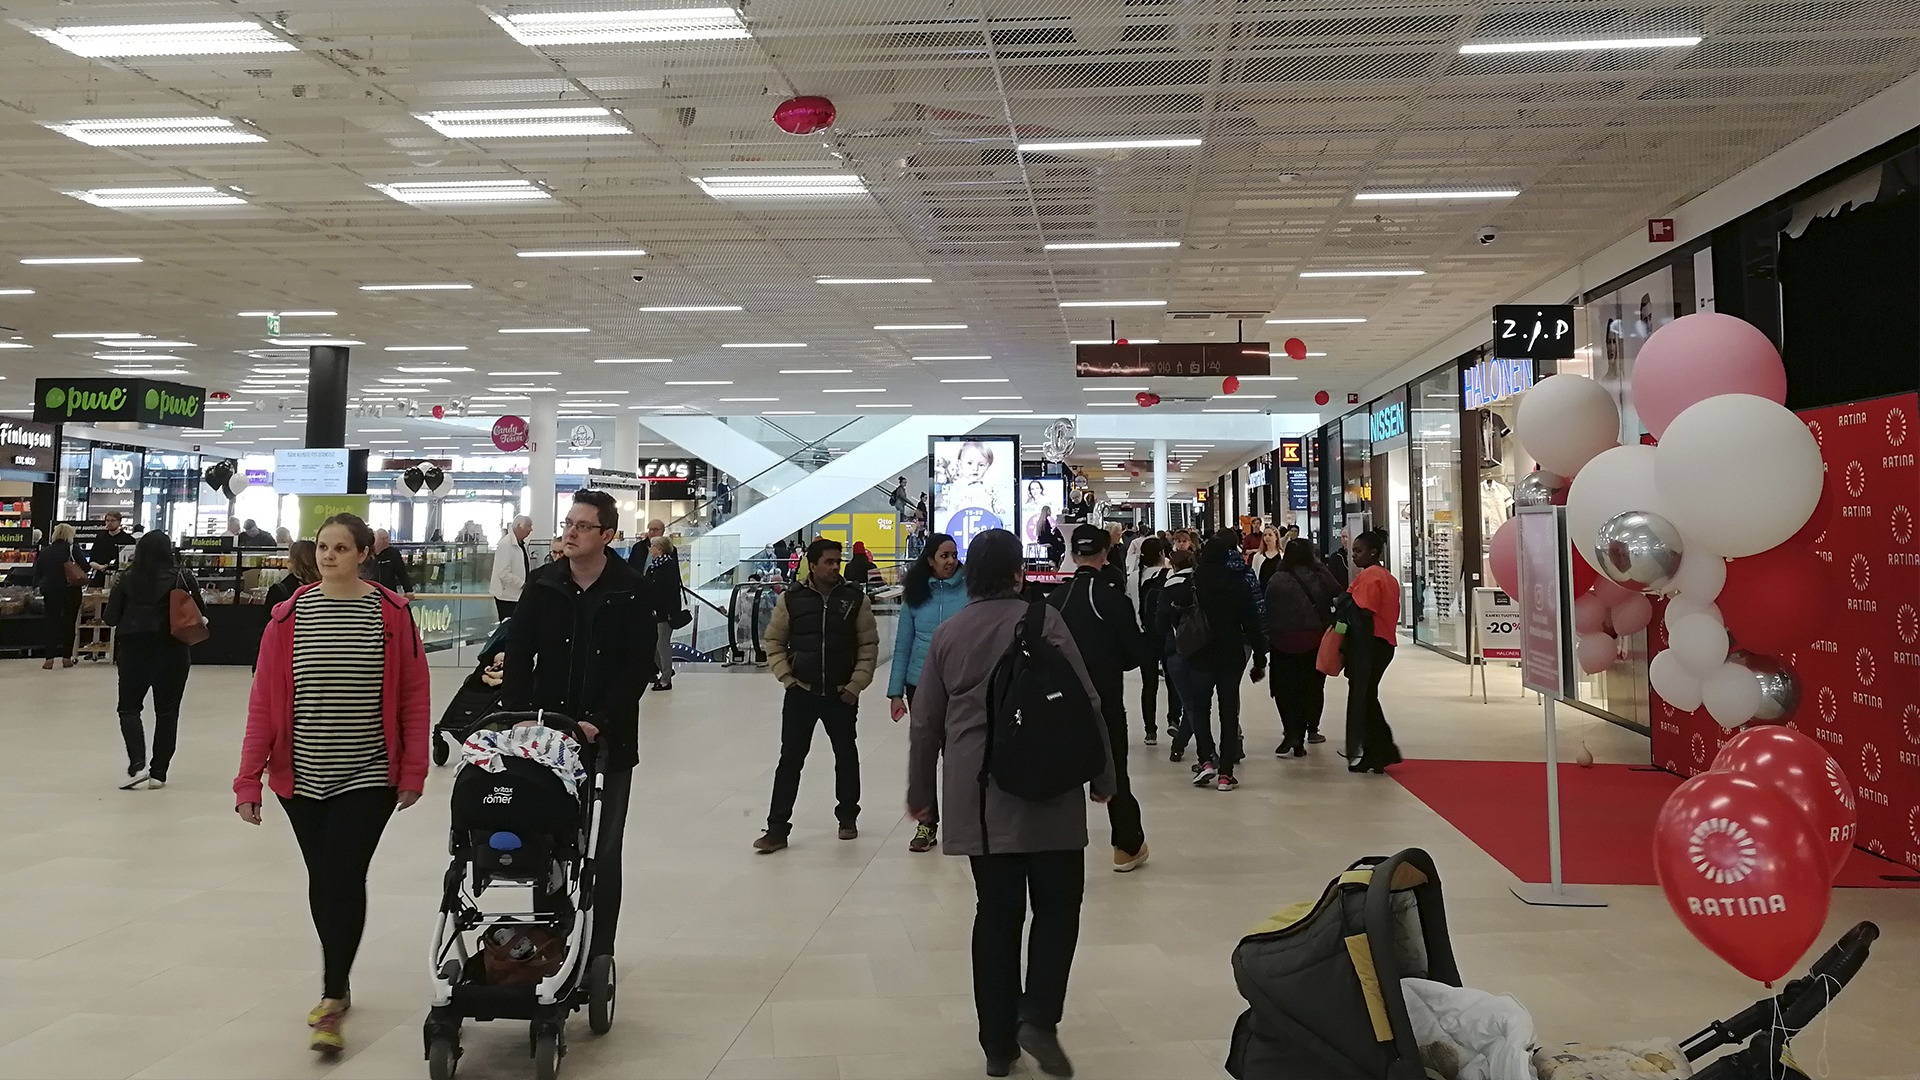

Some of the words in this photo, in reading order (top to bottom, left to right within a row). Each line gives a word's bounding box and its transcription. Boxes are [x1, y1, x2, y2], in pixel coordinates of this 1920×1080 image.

[1463, 358, 1534, 411] HALONEN
[67, 386, 128, 417] pure
[159, 390, 199, 420] pure
[1370, 401, 1404, 444] NISSEN
[1838, 412, 1867, 427] RATINA
[0, 422, 52, 449] Finlayson
[493, 423, 523, 437] Candy
[500, 433, 523, 444] Town
[1882, 453, 1914, 469] RATINA
[1842, 505, 1872, 517] RATINA
[0, 533, 24, 542] kinät
[191, 538, 222, 546] Makeiset
[1888, 553, 1920, 566] RATINA
[1847, 598, 1877, 612] RATINA
[1853, 691, 1883, 709] RATINA
[1660, 721, 1680, 735] RATINA
[1816, 727, 1844, 745] RATINA
[482, 794, 513, 804] römer
[1858, 785, 1889, 807] RATINA
[1687, 894, 1786, 917] RATINA
